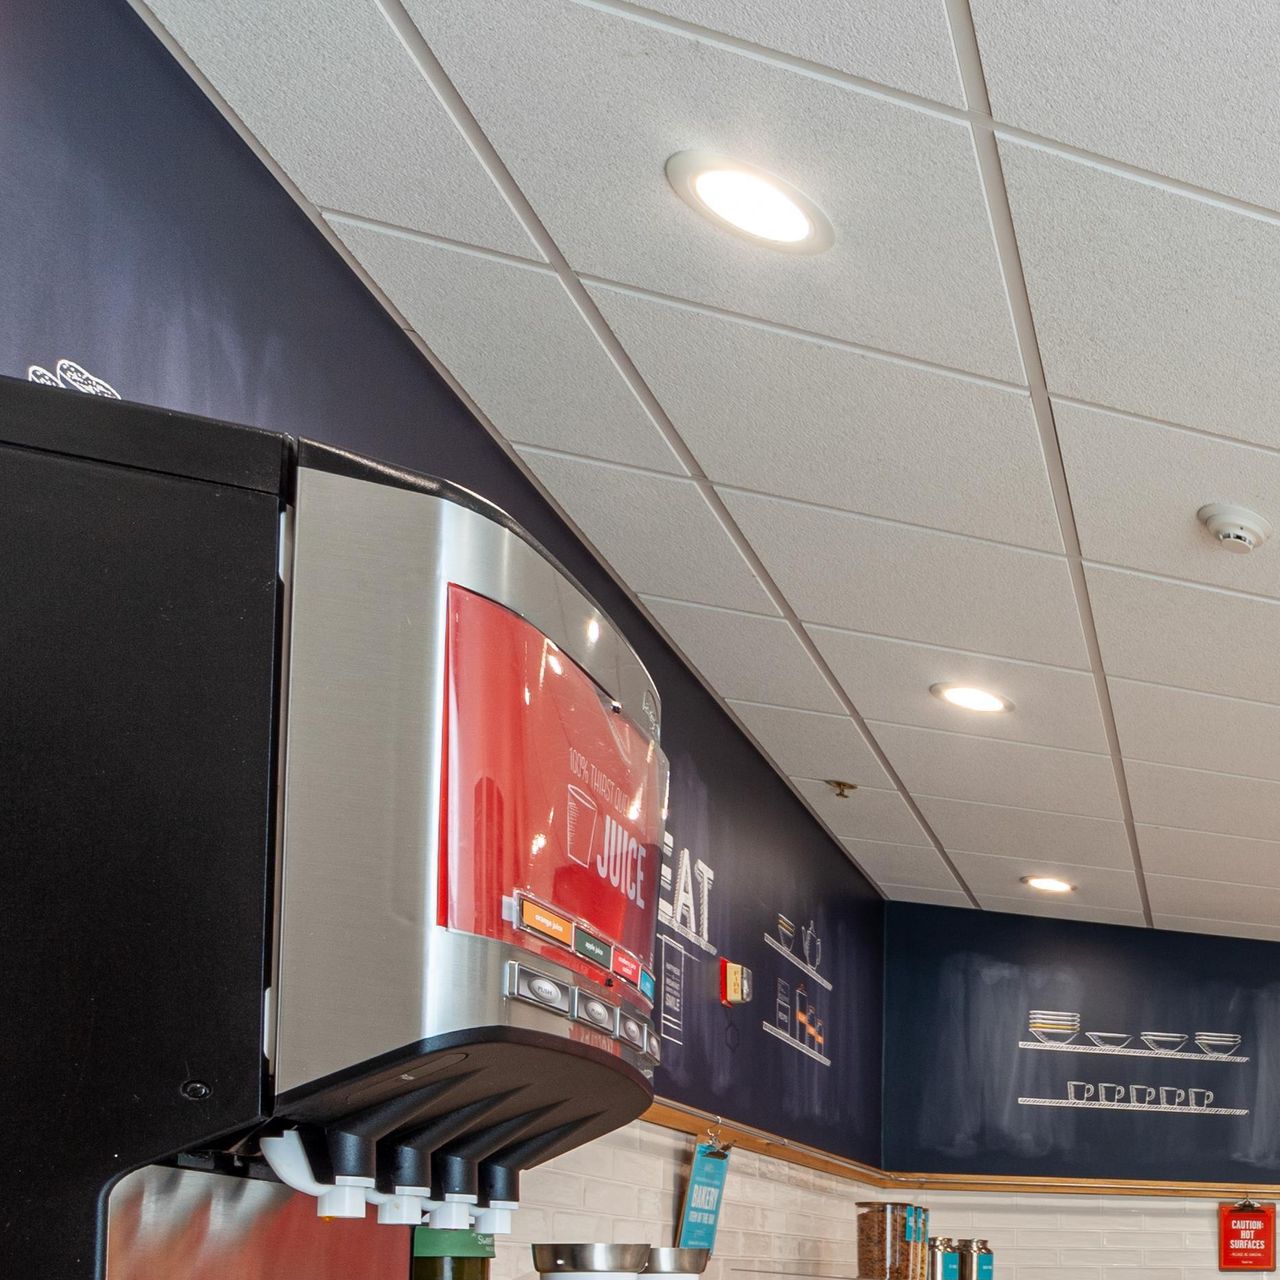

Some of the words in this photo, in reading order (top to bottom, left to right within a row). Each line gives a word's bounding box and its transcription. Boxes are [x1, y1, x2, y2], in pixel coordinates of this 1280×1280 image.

[597, 814, 646, 910] JUICE
[691, 1184, 720, 1210] BAKERY
[1231, 1220, 1264, 1229] CAUTION:
[1240, 1230, 1255, 1239] HOT
[1230, 1240, 1265, 1249] SURFACES
